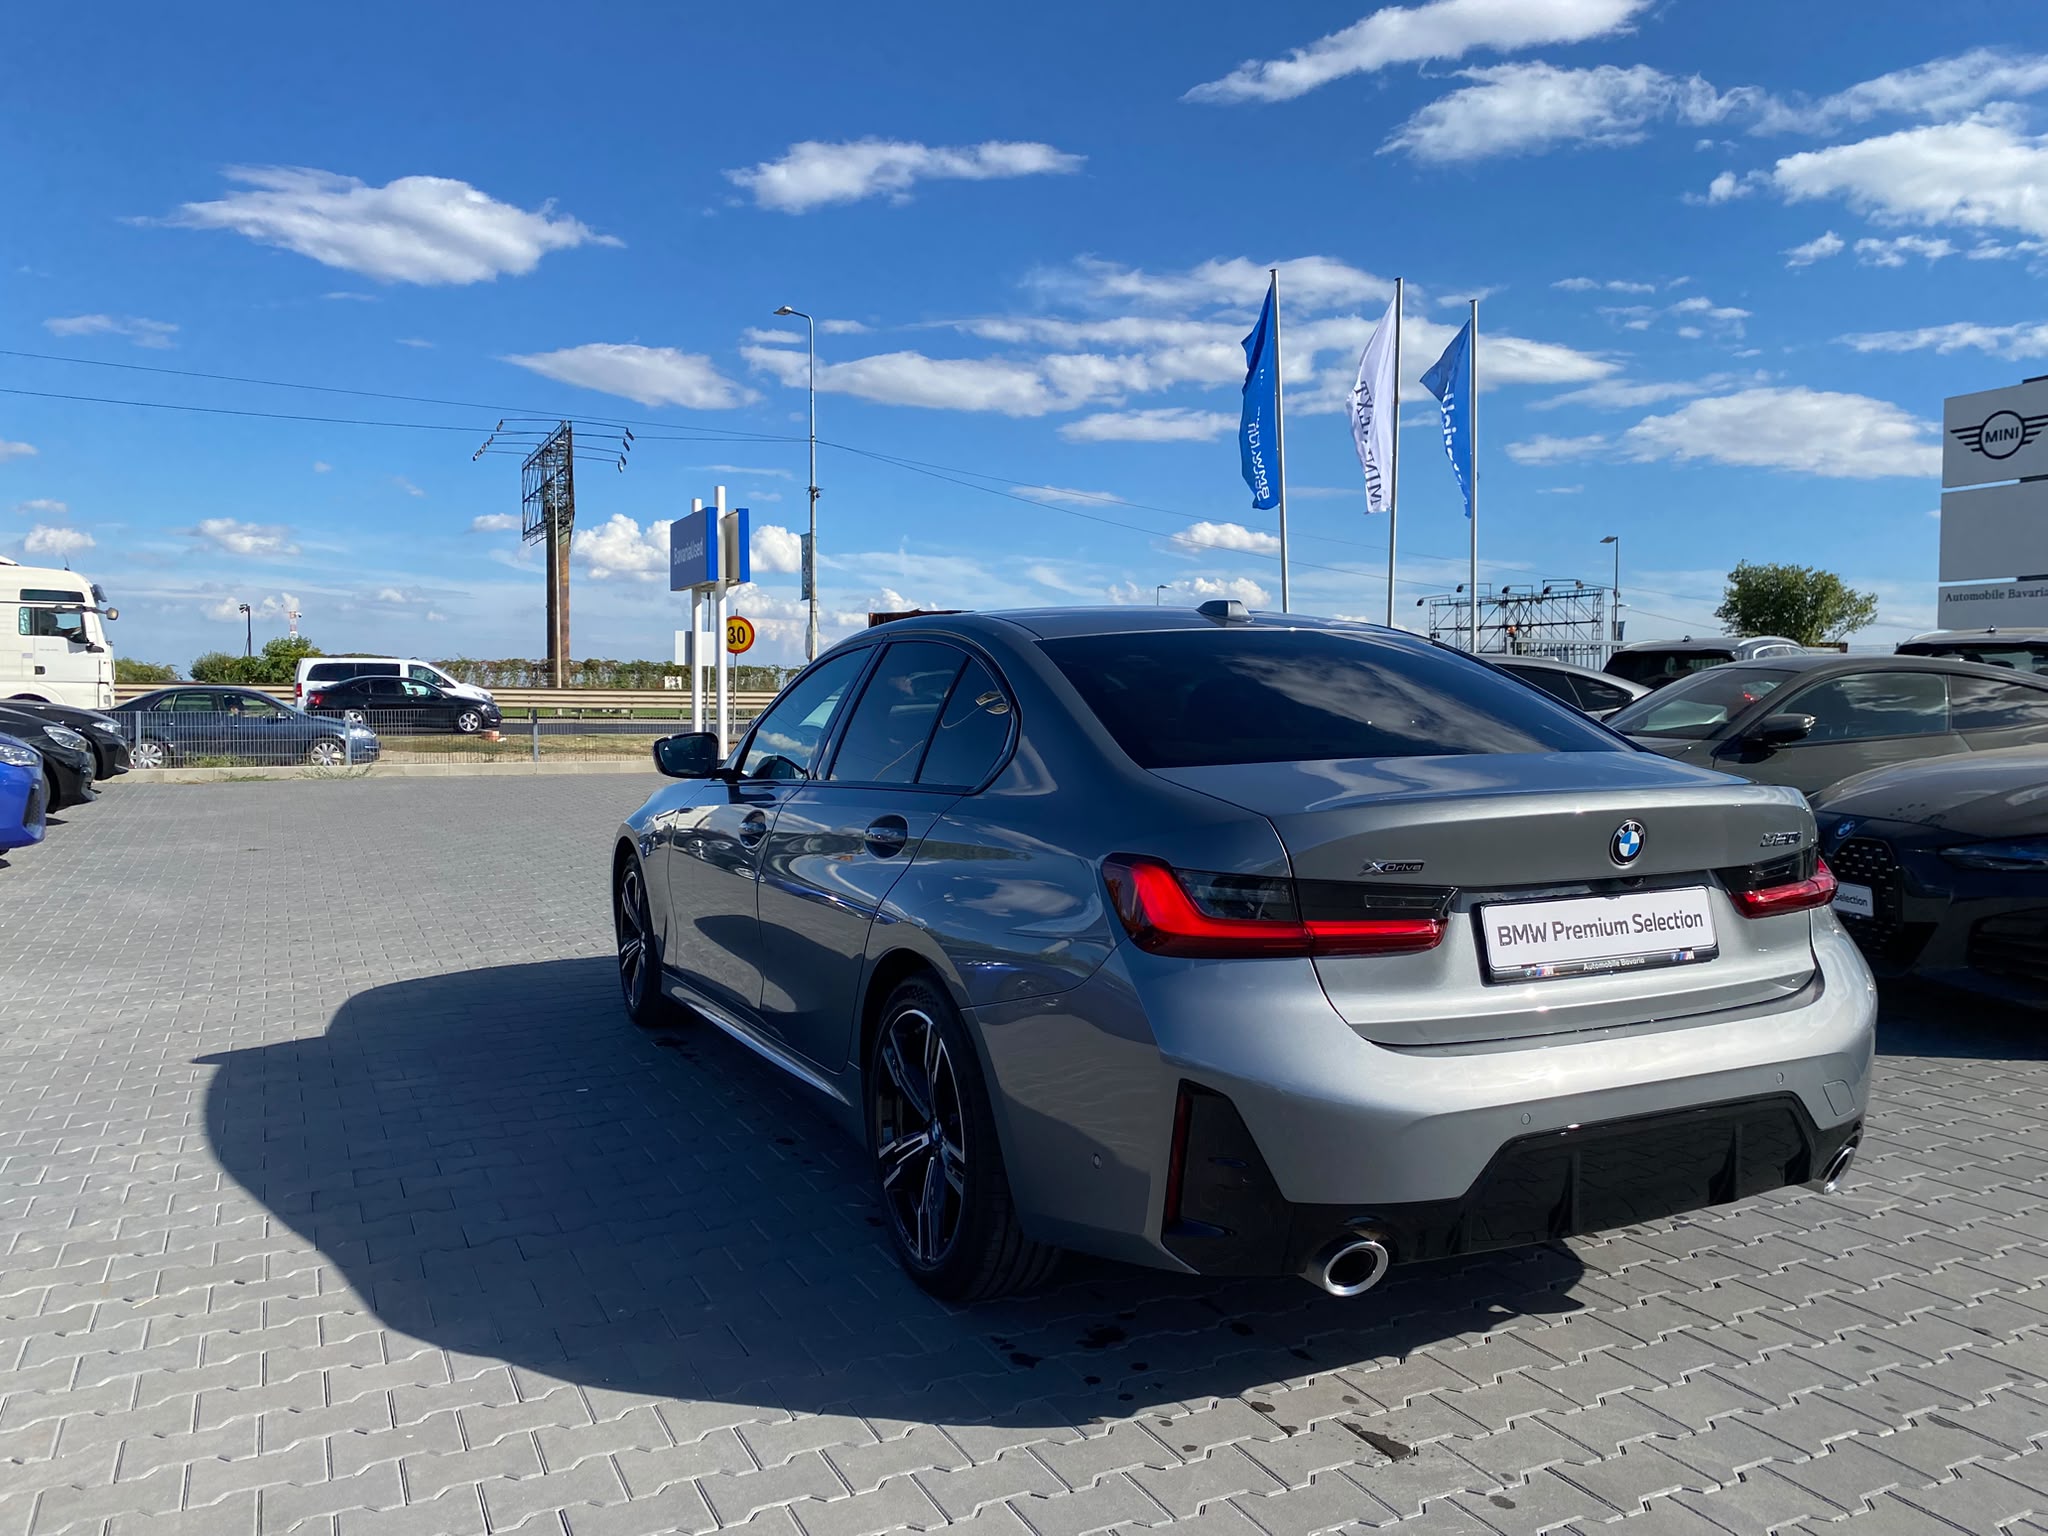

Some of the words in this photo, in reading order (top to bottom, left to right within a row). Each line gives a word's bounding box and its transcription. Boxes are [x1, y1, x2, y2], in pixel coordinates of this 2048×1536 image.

[1984, 426, 2020, 444] MINI
[1945, 587, 2005, 603] Automobile
[727, 626, 746, 645] 30
[1497, 922, 1548, 947] BMW
[1551, 917, 1630, 942] Premium
[1632, 909, 1704, 934] Selection
[1583, 959, 1620, 971] Automobile
[1621, 957, 1646, 967] Bavaria
